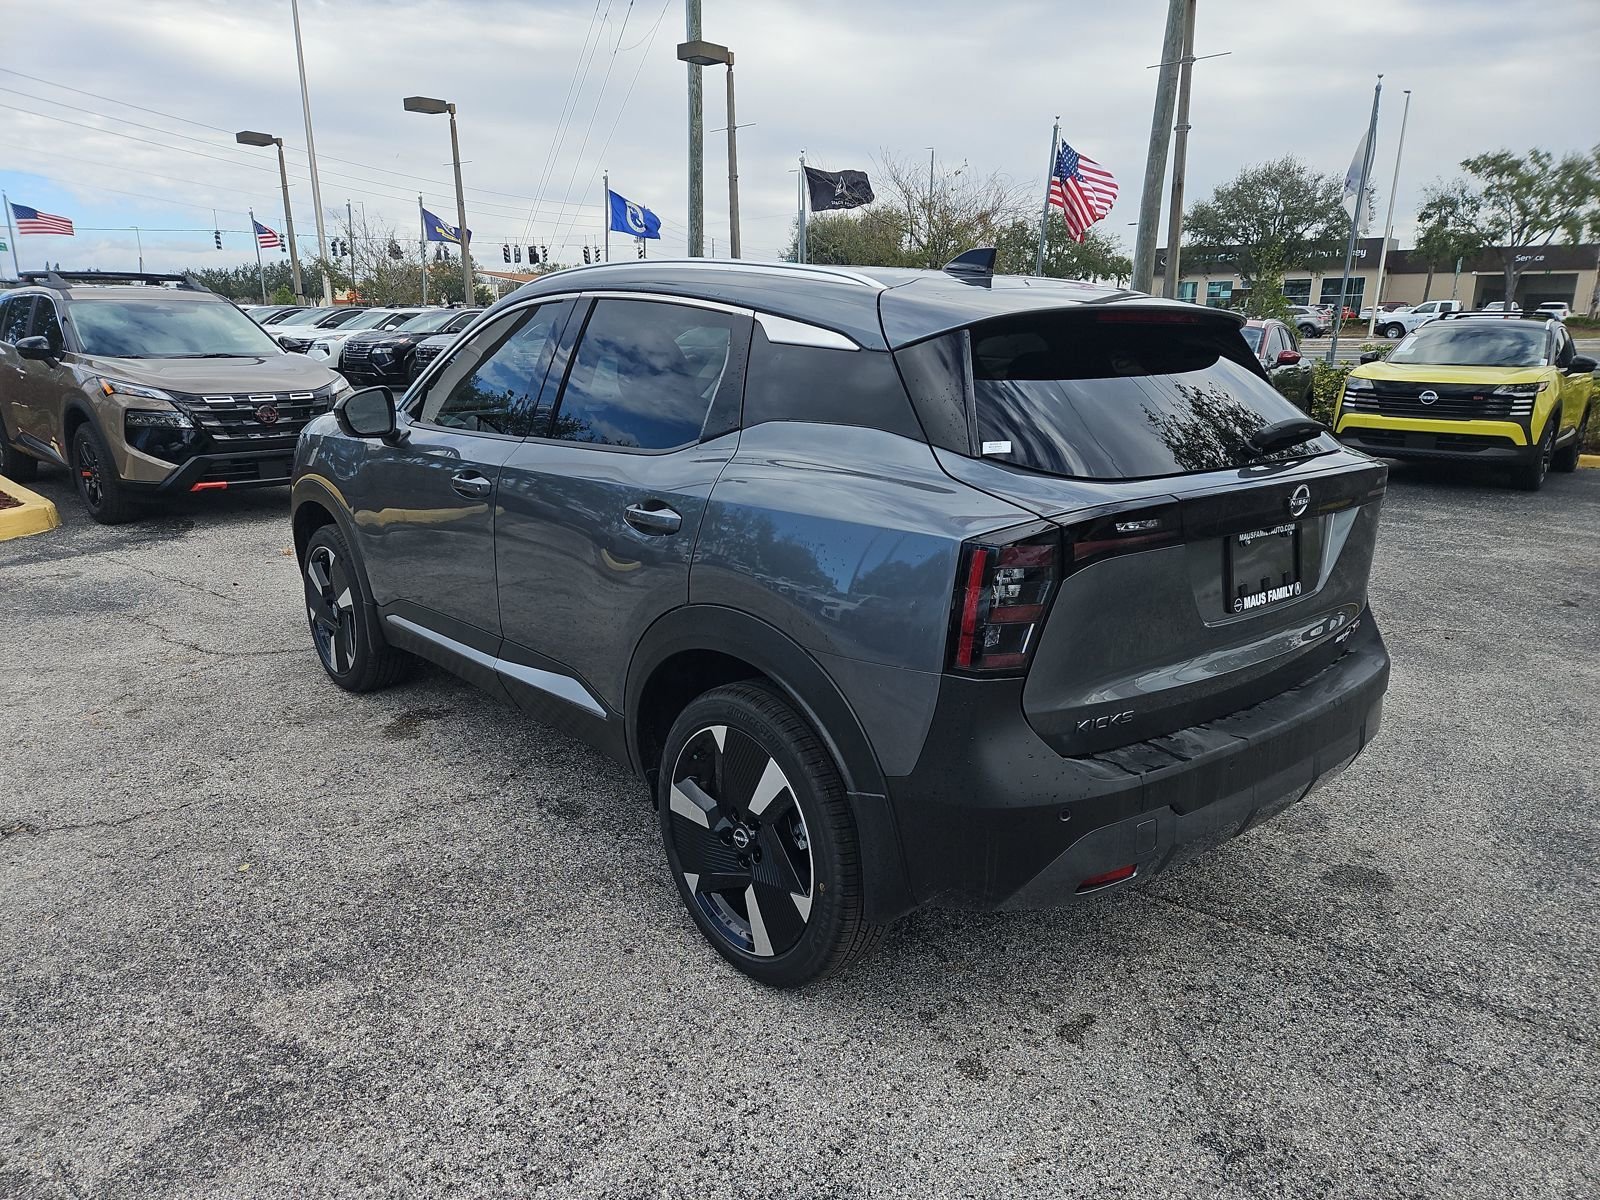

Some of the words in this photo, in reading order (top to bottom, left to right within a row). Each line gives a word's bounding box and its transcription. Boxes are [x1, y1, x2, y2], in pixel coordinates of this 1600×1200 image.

[1515, 254, 1545, 262] Servce
[1243, 593, 1267, 609] MAUS
[1268, 584, 1294, 602] FAMILY
[1075, 710, 1135, 734] KICKS
